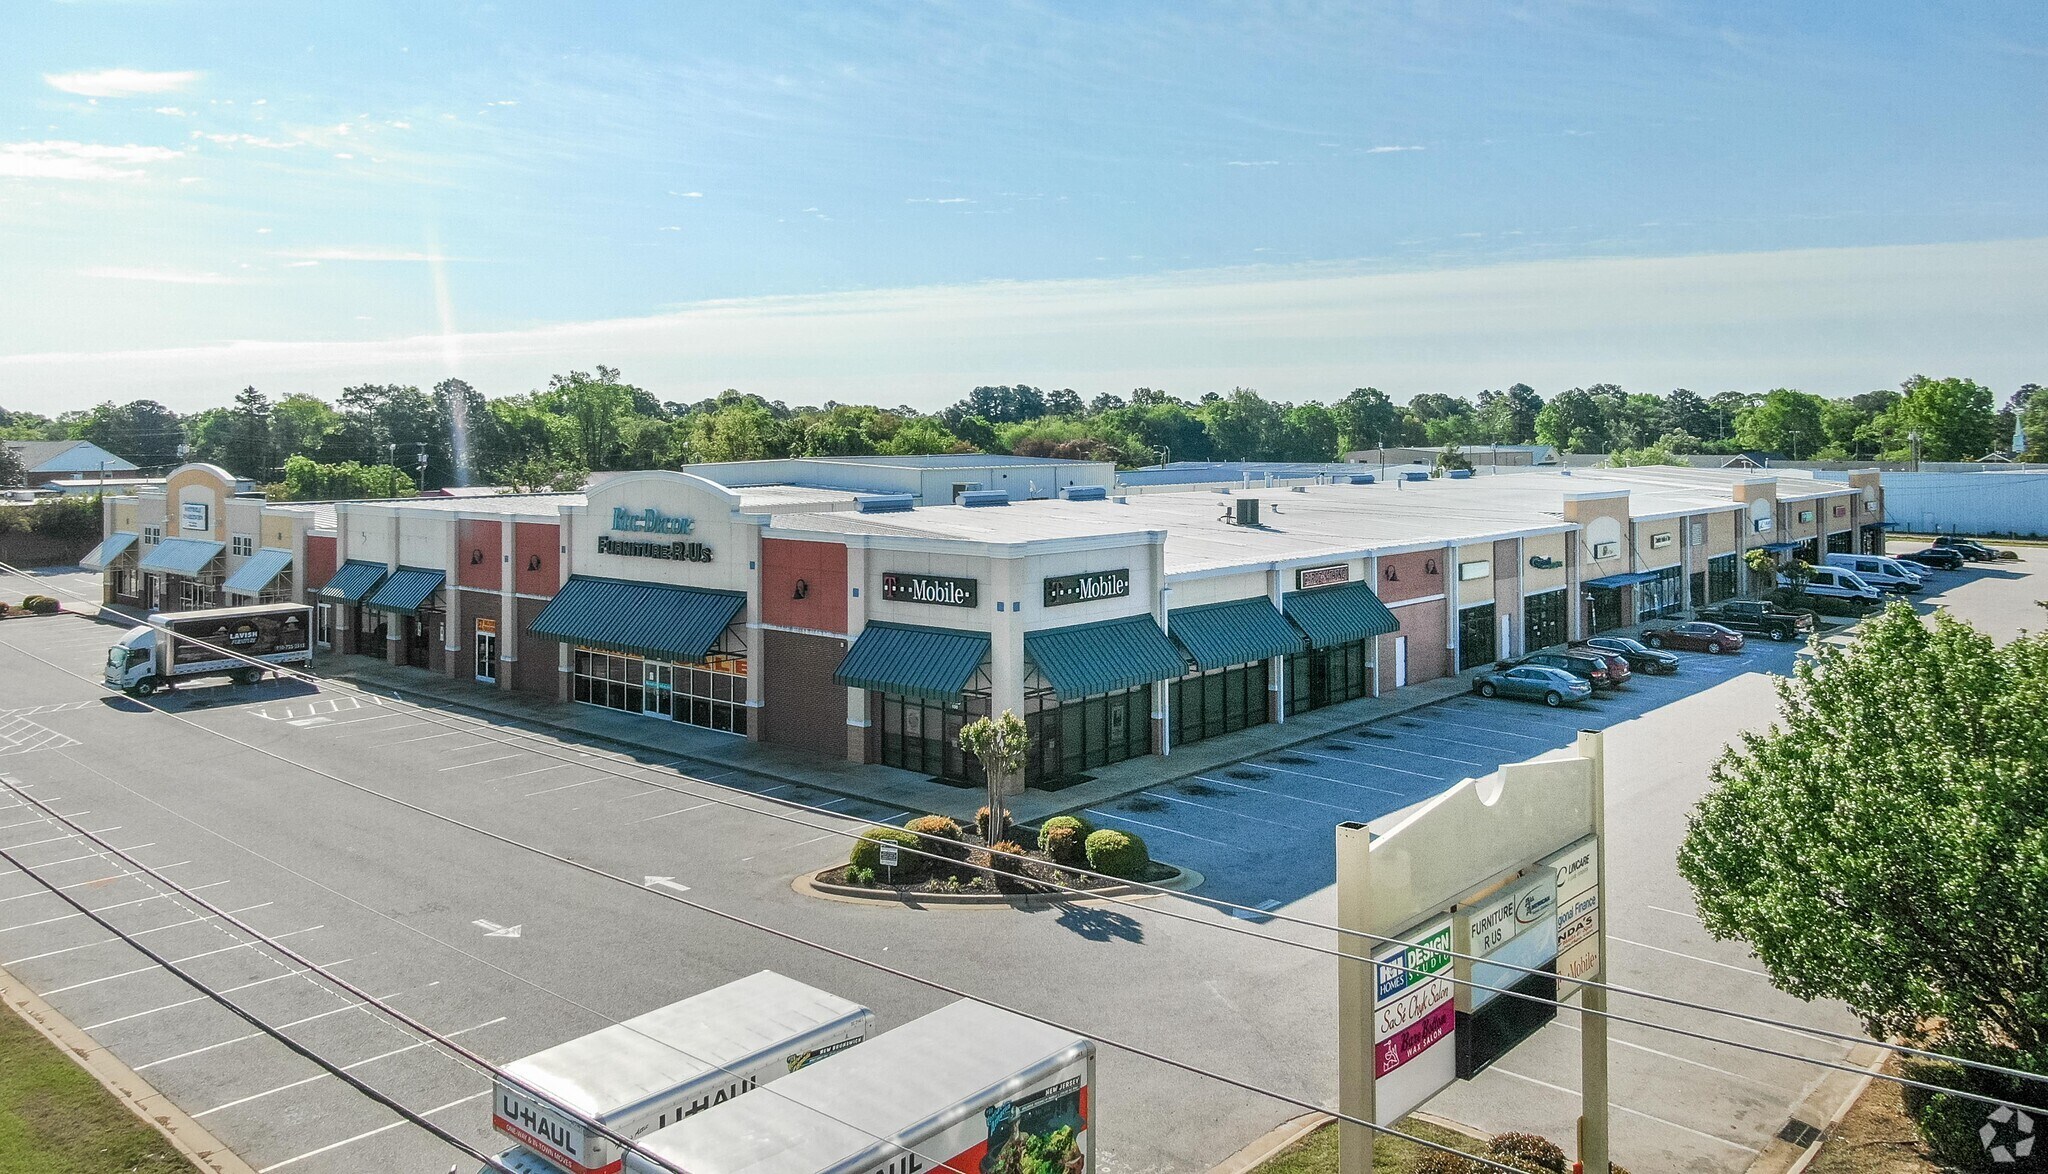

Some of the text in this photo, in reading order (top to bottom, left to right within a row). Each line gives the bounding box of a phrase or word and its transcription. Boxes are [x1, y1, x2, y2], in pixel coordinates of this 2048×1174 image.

[229, 631, 258, 640] LAVISH
[1472, 902, 1513, 938] FURNITURE
[1557, 906, 1574, 930] gional
[1575, 895, 1596, 915] Finance
[1484, 928, 1502, 949] R US
[1558, 916, 1592, 943] NDA'S
[1407, 932, 1449, 970] DESIGN
[1408, 948, 1449, 981] STUDIO
[1380, 974, 1405, 996] HOMES
[1428, 980, 1448, 1006] Salon
[819, 1046, 832, 1055] NEW
[1406, 1028, 1442, 1057] WAX SALON
[1045, 1077, 1080, 1096] NEW JERSEY
[503, 1095, 576, 1156] U-HAUL
[532, 1139, 554, 1157] IN-TOWN
[554, 1152, 573, 1168] MOVES
